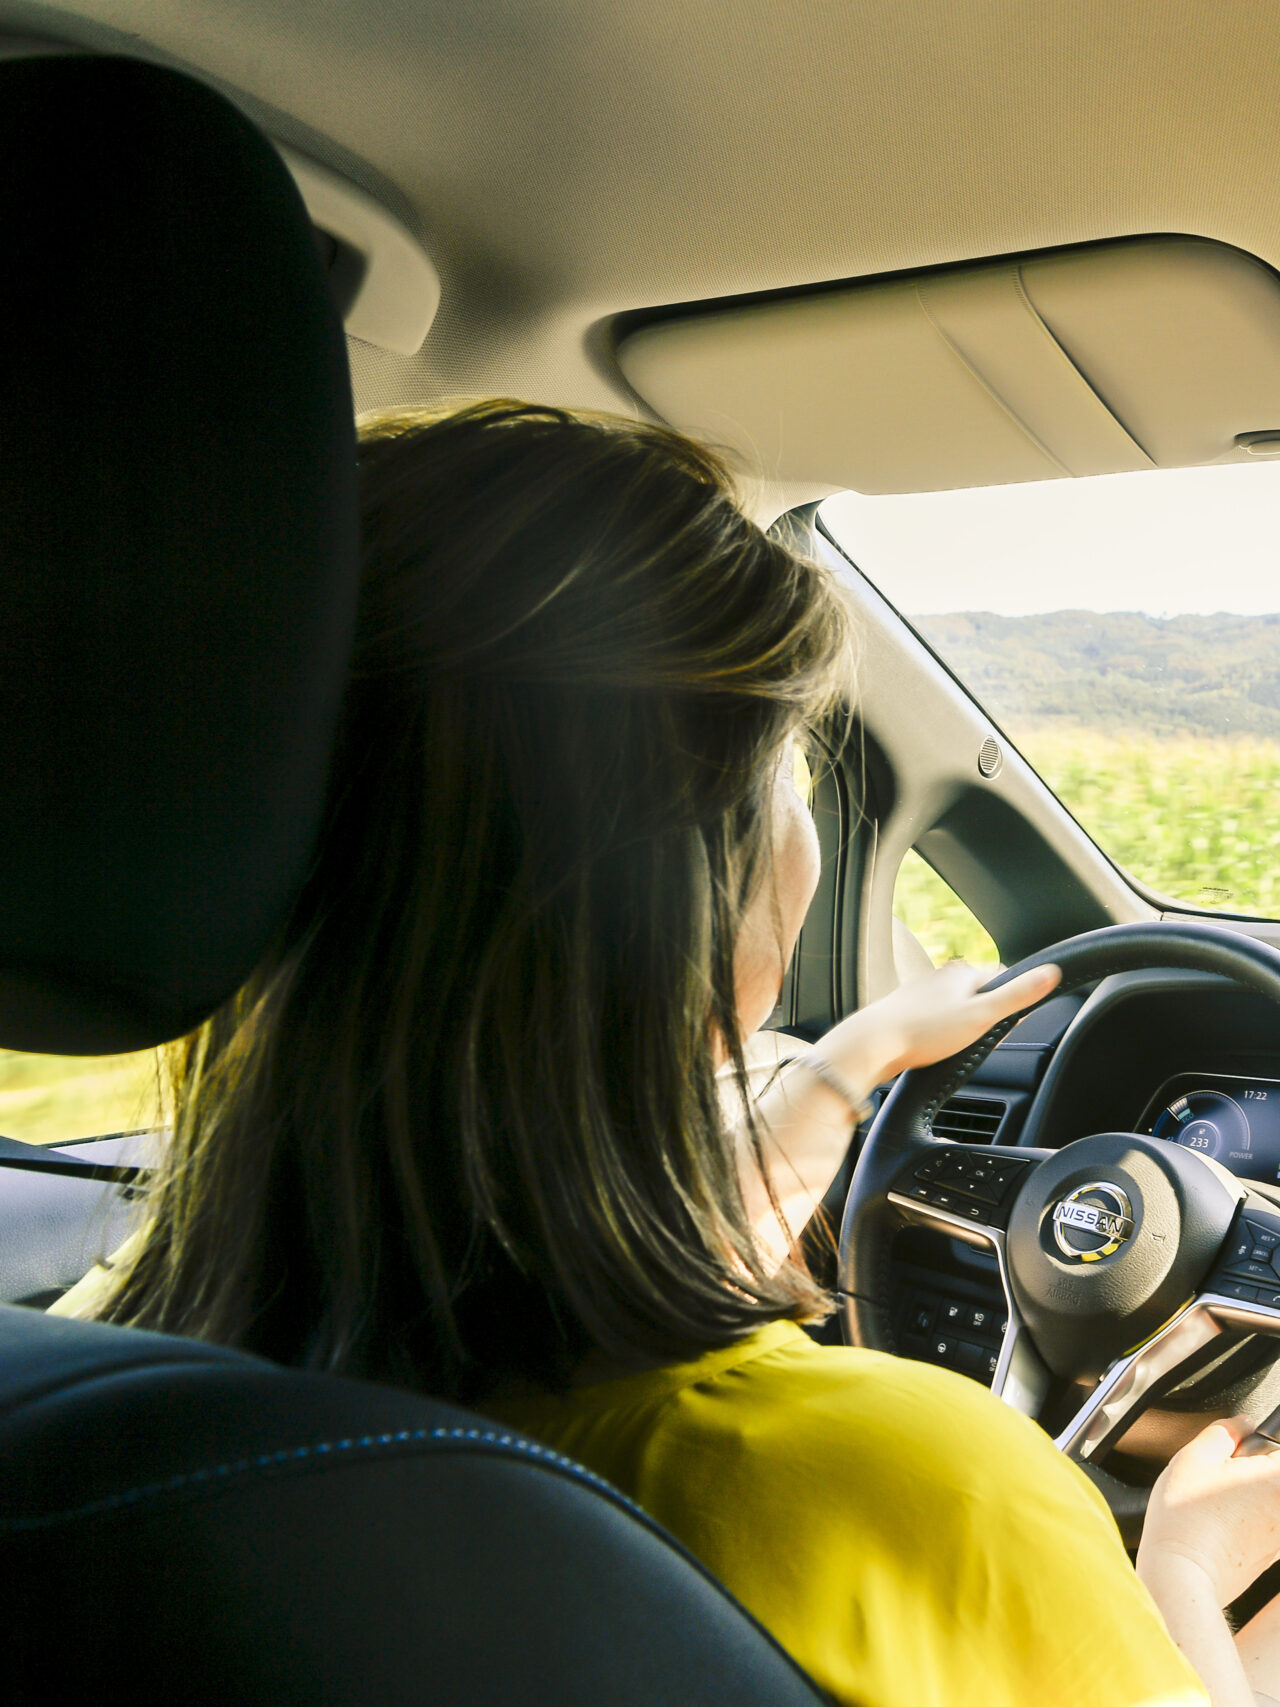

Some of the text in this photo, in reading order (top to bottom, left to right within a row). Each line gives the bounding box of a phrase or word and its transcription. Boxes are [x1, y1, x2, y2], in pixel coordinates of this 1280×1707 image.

[1244, 1090, 1268, 1101] 17:22
[1189, 1137, 1209, 1148] 233
[1060, 1205, 1124, 1237] NISSAN
